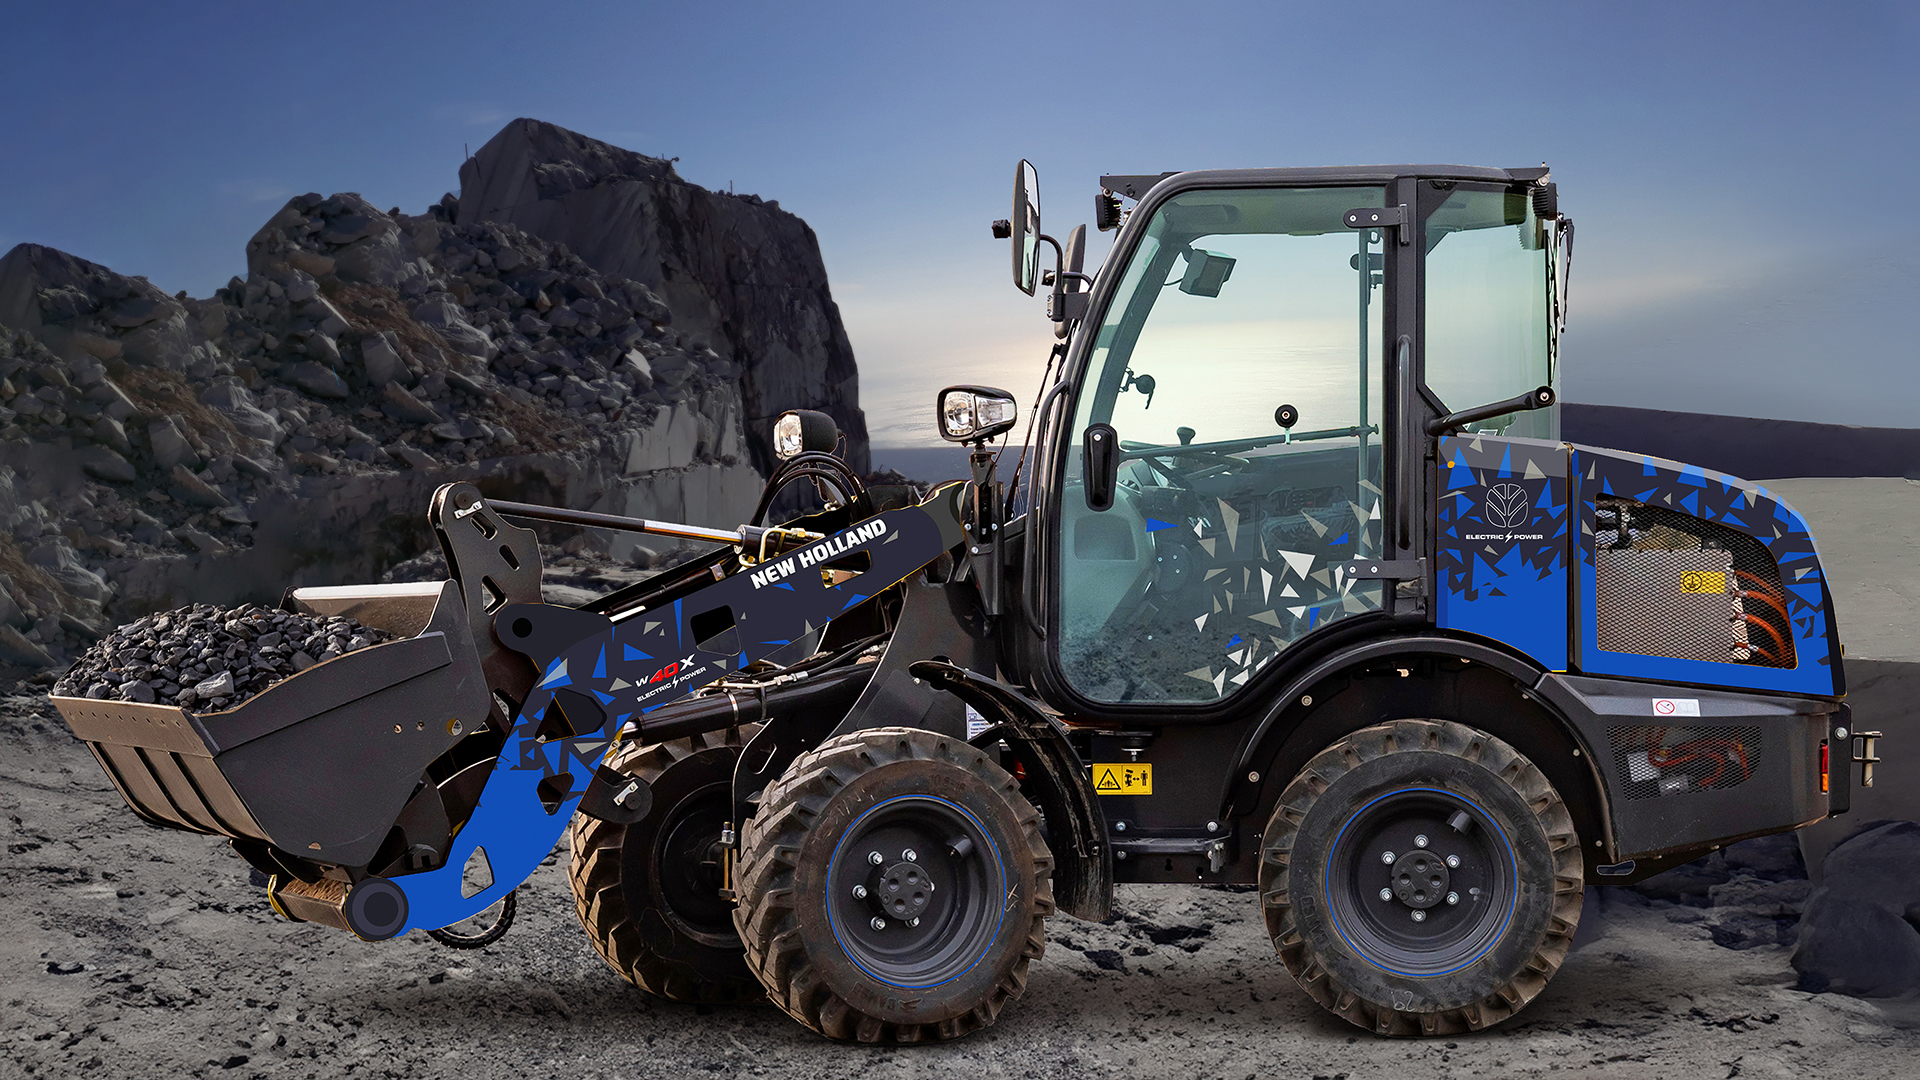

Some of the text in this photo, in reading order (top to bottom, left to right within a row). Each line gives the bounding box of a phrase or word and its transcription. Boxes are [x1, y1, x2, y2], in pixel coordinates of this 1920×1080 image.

[750, 519, 887, 590] NEW HOLLAND
[635, 653, 696, 688] W40X
[636, 666, 707, 703] ELECTRIC POWER
